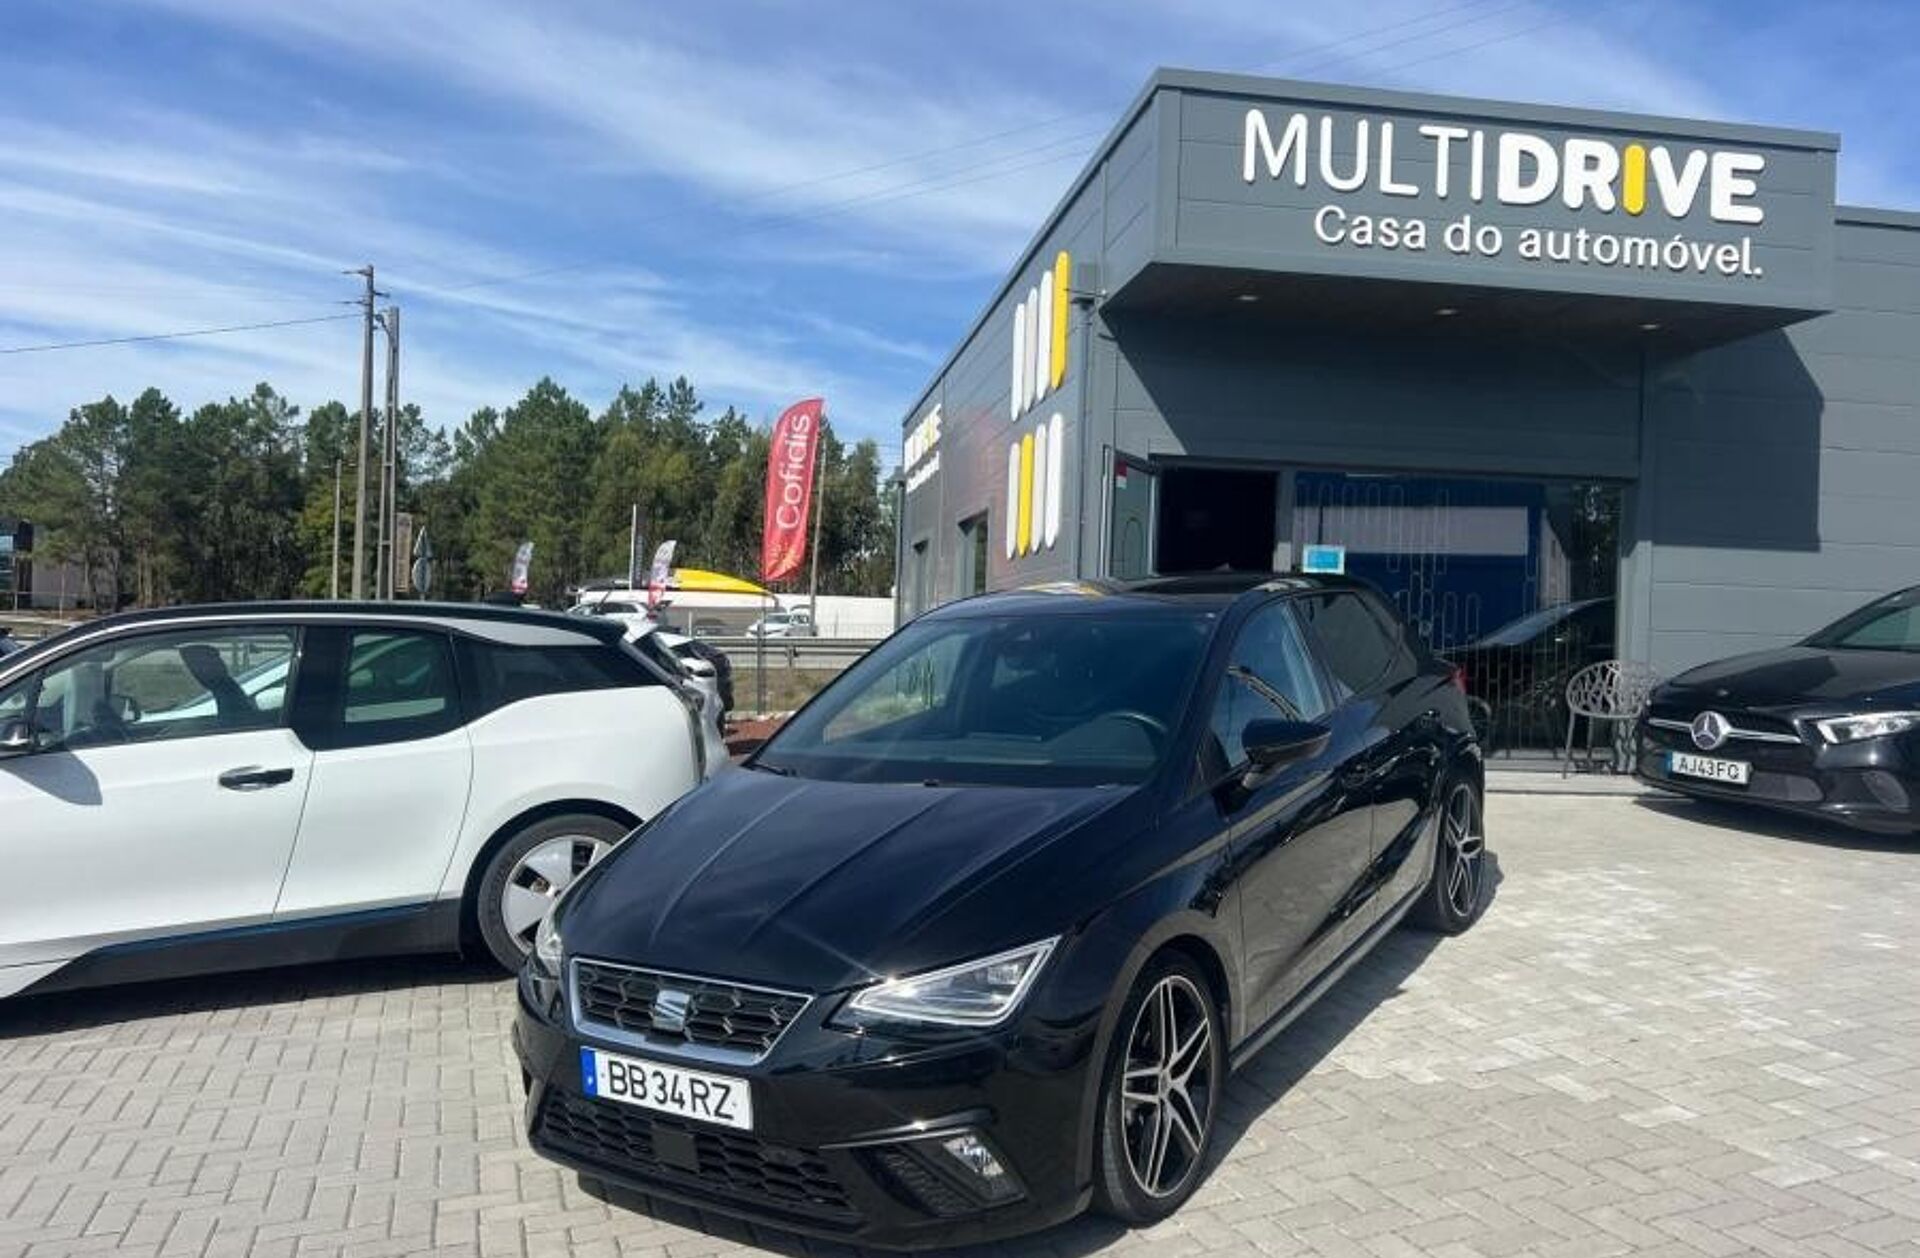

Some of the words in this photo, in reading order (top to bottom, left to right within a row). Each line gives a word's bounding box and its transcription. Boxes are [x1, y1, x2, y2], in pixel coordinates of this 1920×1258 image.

[1242, 108, 1765, 224] MULTIDRIVE
[1314, 205, 1426, 250] Casa
[1443, 214, 1503, 256] do
[1518, 228, 1764, 277] automóvel.
[775, 413, 811, 530] Cofidis
